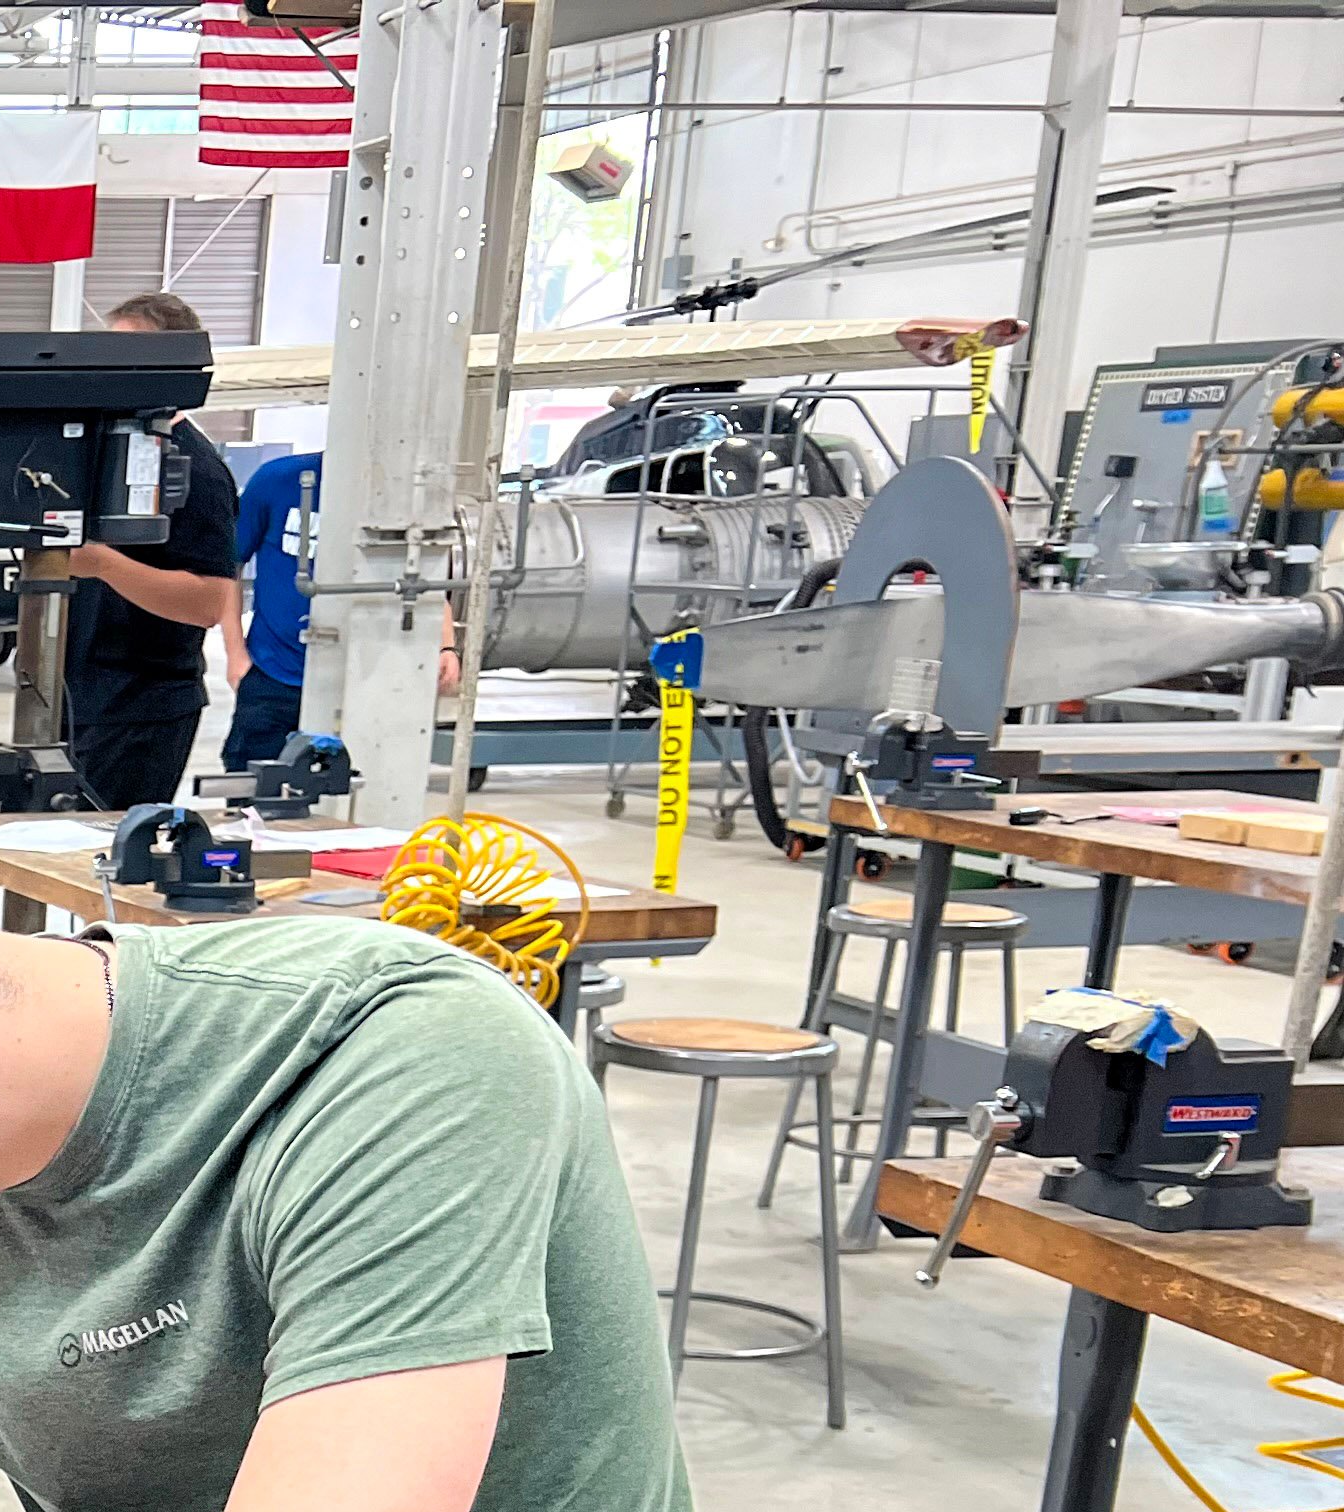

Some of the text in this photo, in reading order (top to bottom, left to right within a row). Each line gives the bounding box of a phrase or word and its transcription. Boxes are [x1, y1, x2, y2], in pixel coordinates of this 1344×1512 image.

[661, 723, 684, 778] NOT
[658, 787, 681, 827] DO
[81, 1299, 189, 1355] MAGELLAN
